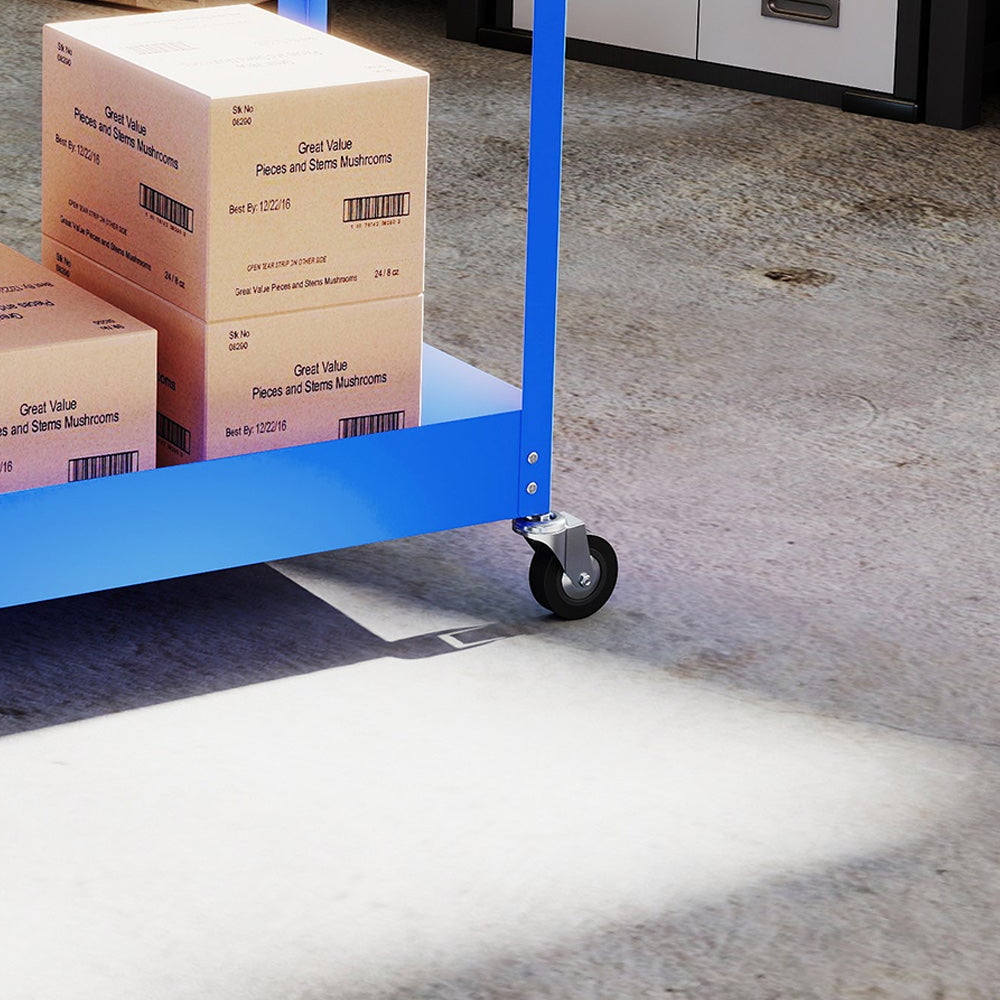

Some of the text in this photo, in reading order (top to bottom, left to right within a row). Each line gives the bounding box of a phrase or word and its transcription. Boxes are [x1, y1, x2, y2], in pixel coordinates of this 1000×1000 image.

[232, 104, 254, 115] Stk No
[104, 105, 148, 137] Great Value
[74, 107, 179, 171] Pieces and Stems Mushrooms
[298, 138, 353, 155] Great Value
[55, 134, 101, 167] Best By: 12/22/16
[256, 152, 393, 177] Pieces and Stems Mushrooms
[229, 198, 291, 216] Best By: 12/22/16
[235, 274, 358, 297] Great Value Pieces and Stems Mushrooms
[229, 330, 250, 340] Stk No
[294, 360, 348, 377] Great Value
[252, 373, 387, 399] Pieces and Stems Mushrooms
[19, 399, 77, 416] Great Value
[10, 423, 29, 435] and
[32, 419, 62, 433] Stems
[64, 411, 119, 429] Mushrooms
[225, 420, 287, 438] Best By: 12/22/16
